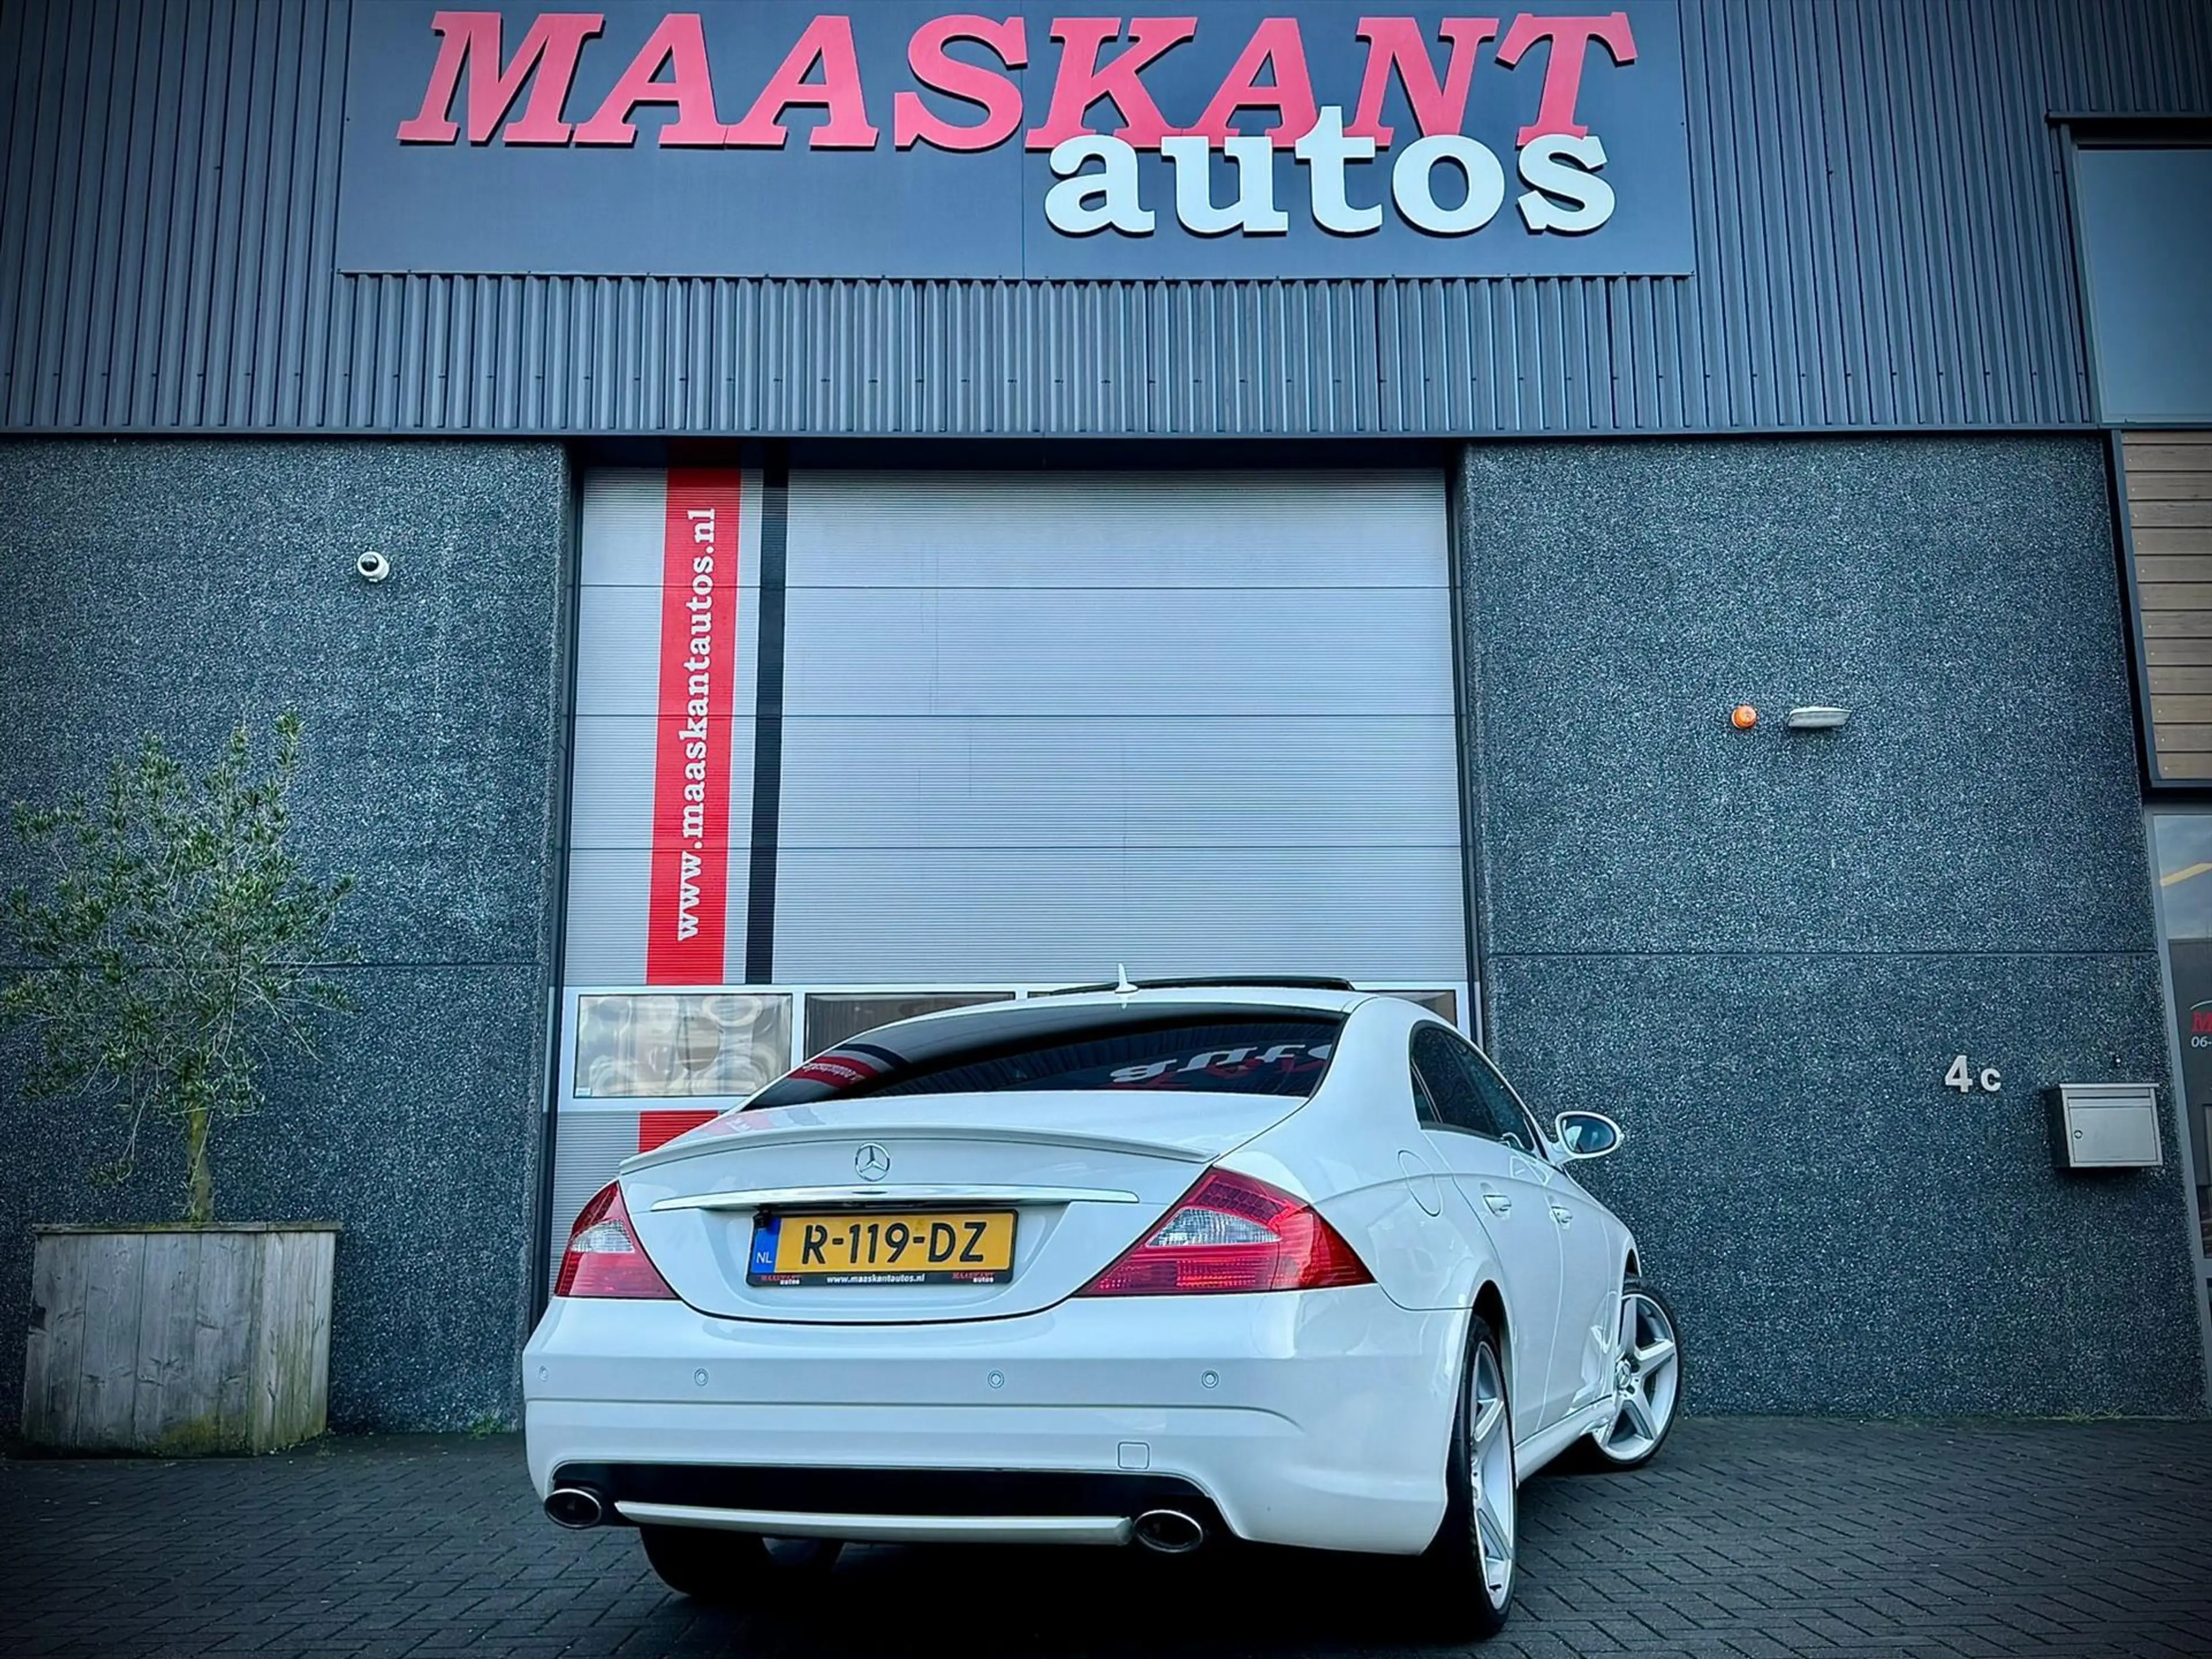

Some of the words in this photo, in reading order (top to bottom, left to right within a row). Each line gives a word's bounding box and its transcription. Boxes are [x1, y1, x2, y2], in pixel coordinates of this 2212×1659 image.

[397, 12, 1638, 148] MAASKANT
[1044, 105, 1615, 233] autos
[678, 508, 715, 941] www.maaskantautos.nl
[756, 1252, 772, 1264] NL
[802, 1222, 987, 1264] R-119-DZ
[826, 1273, 925, 1283] www.maaskantautos.nl
